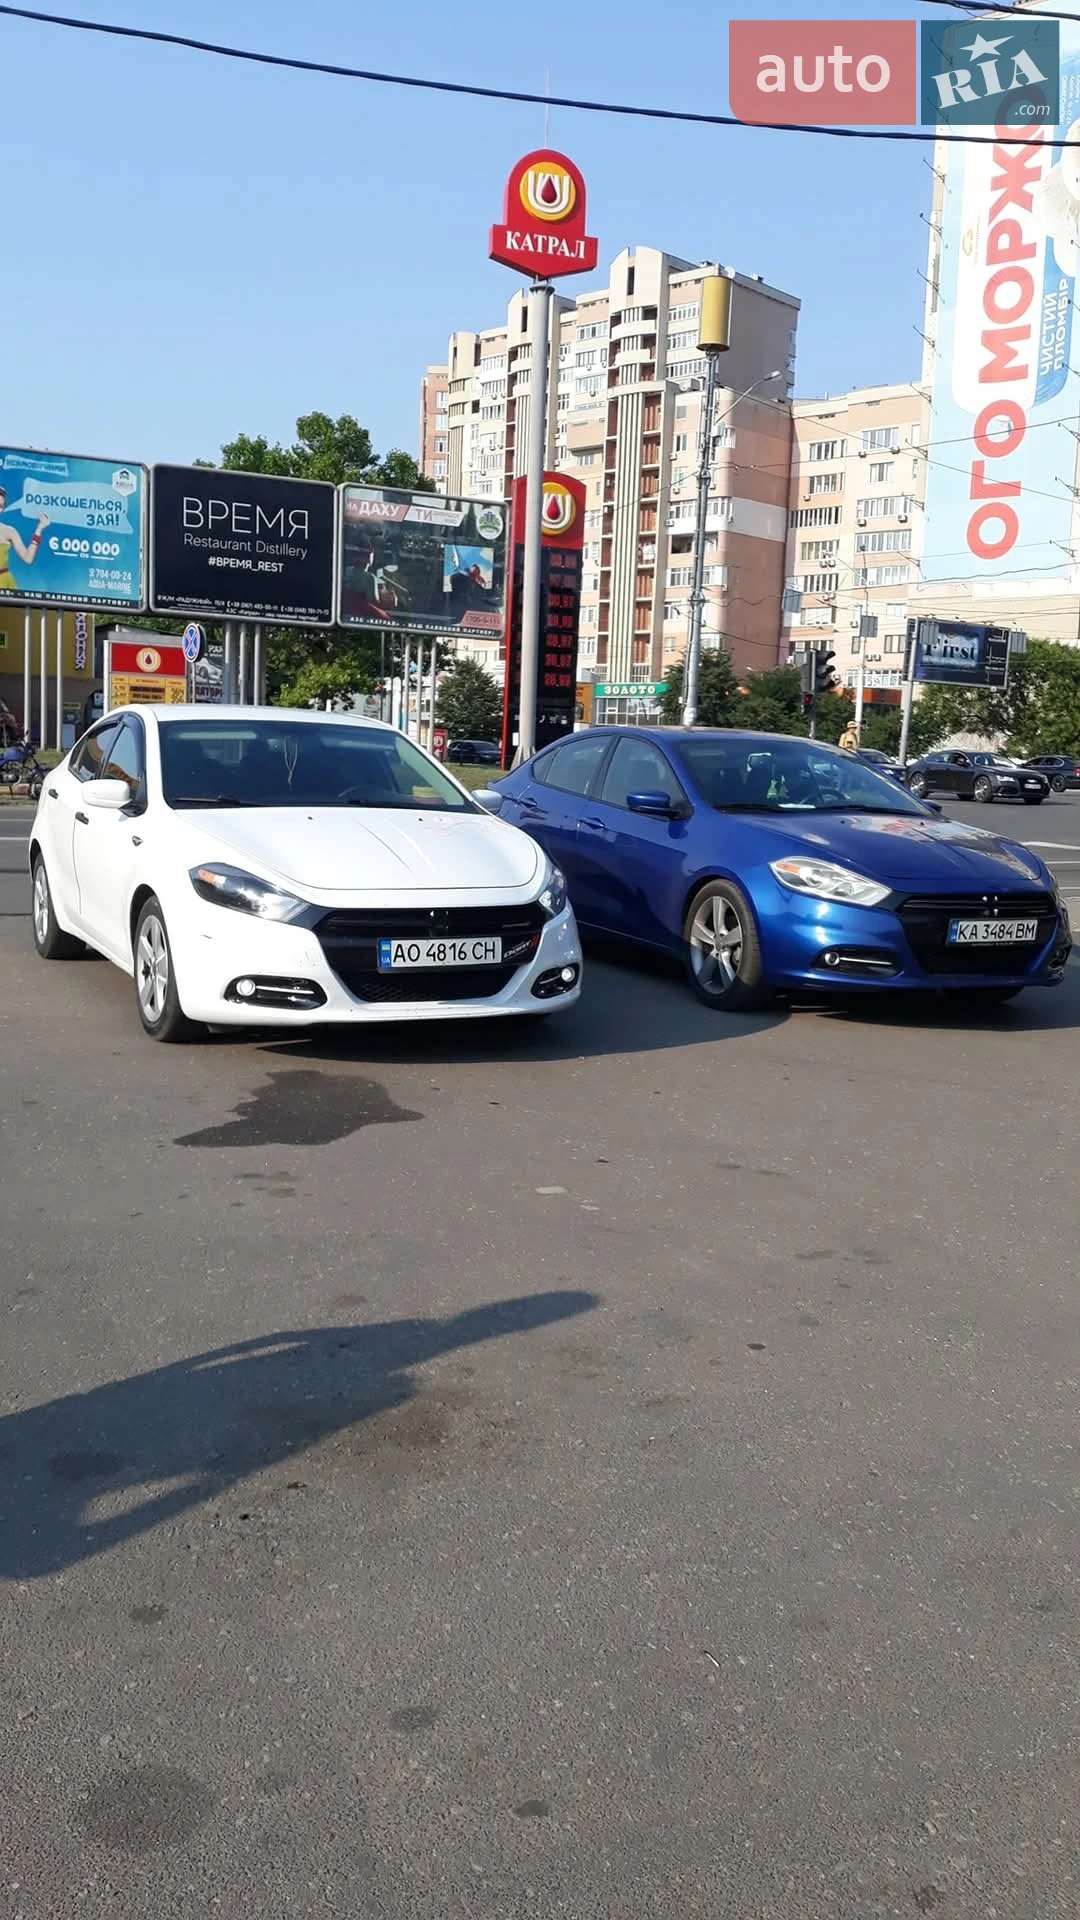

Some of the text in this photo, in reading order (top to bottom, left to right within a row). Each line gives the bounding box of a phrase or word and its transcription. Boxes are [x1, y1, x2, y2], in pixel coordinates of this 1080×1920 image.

[505, 230, 586, 259] КАТРАЛ
[1039, 291, 1058, 376] ЧИСТИЙ
[1054, 278, 1070, 371] ПЛОМБІР
[966, 399, 1026, 560] ОГО
[25, 493, 126, 514] РОЗКОШЕЛЬСЯ,
[359, 501, 401, 517] ДАХУ
[415, 509, 433, 521] ТИ
[86, 514, 119, 527] ЗАЯ!
[183, 496, 309, 540] ВРЕМЯ
[49, 536, 120, 556] 6 000 000
[184, 533, 308, 560] Restaurant Distillery
[208, 556, 284, 573] #ВРЕМЯ_REST
[604, 685, 656, 695] ЗОЛОТО
[959, 923, 1036, 940] KA 3484 BM
[393, 941, 496, 963] AO 4816 CH
